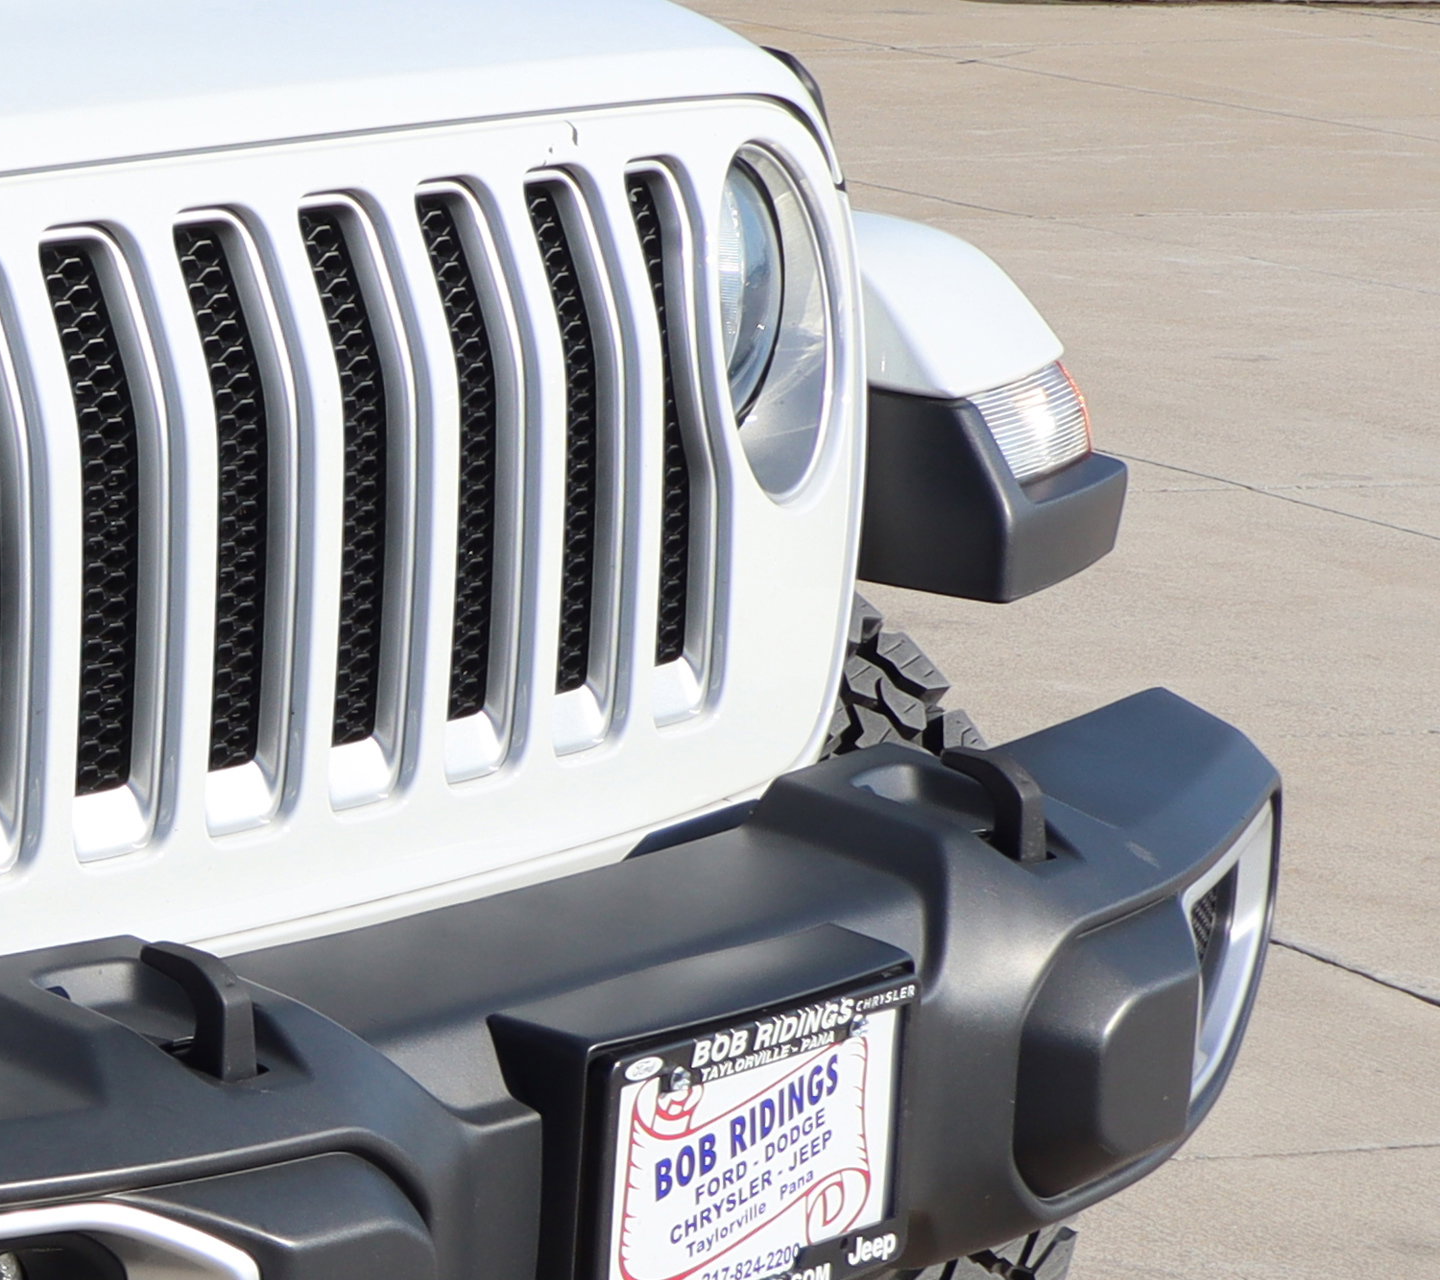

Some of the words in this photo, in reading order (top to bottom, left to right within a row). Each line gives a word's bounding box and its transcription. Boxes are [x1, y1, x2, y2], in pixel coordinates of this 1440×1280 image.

[691, 1029, 748, 1069] BOB
[752, 996, 854, 1052] RIDINGS
[855, 984, 916, 1012] CHRYSLER
[700, 1043, 789, 1082] TAYLORVILLE
[800, 1031, 836, 1052] PANA
[655, 1133, 717, 1202] BOB
[730, 1054, 838, 1159] RIDINGS
[695, 1160, 748, 1206] FORD
[765, 1108, 826, 1163] DODGE
[670, 1170, 773, 1245] CHRYSLER
[789, 1130, 832, 1172] JEEP
[686, 1202, 767, 1258] Taylorville
[780, 1170, 814, 1200] Pana
[847, 1232, 897, 1267] Jeep
